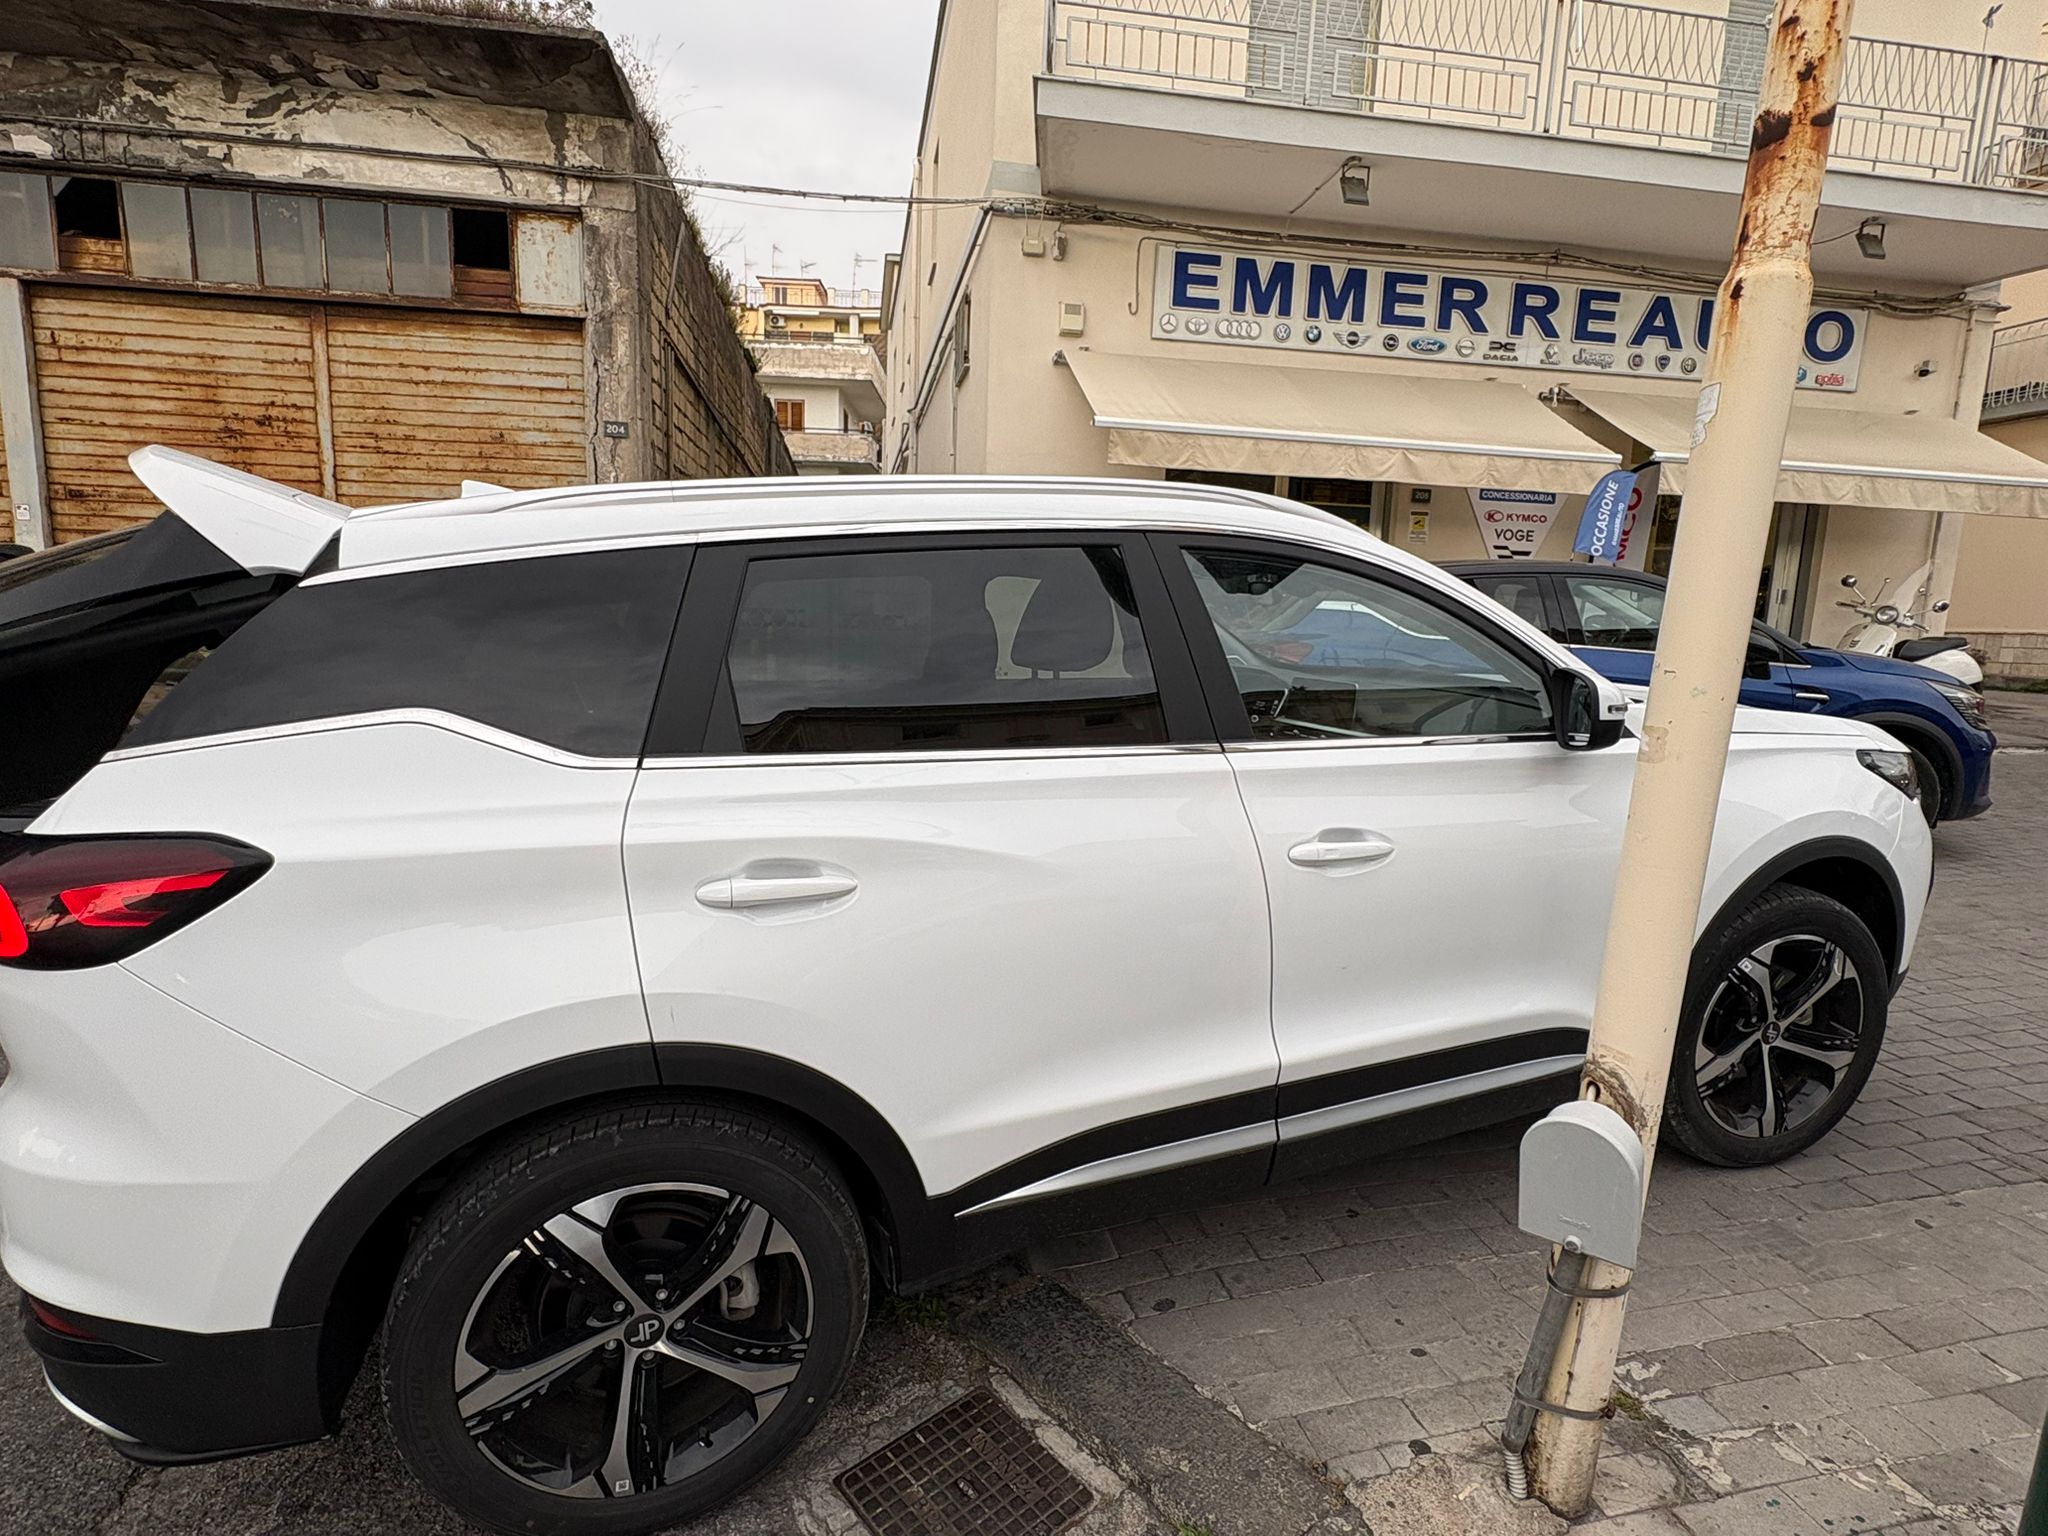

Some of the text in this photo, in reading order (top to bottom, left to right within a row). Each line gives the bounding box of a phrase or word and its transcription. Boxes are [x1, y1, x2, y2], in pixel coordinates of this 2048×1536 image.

[1415, 338, 1440, 352] Ford
[1482, 353, 1519, 362] DACIA
[1573, 347, 1615, 369] Jeep
[606, 424, 625, 434] 204
[1481, 490, 1554, 502] CONCESSIONARIA
[1506, 513, 1547, 524] KYMCO
[1590, 480, 1619, 556] OCCASIONE
[1495, 528, 1535, 542] VOGE
